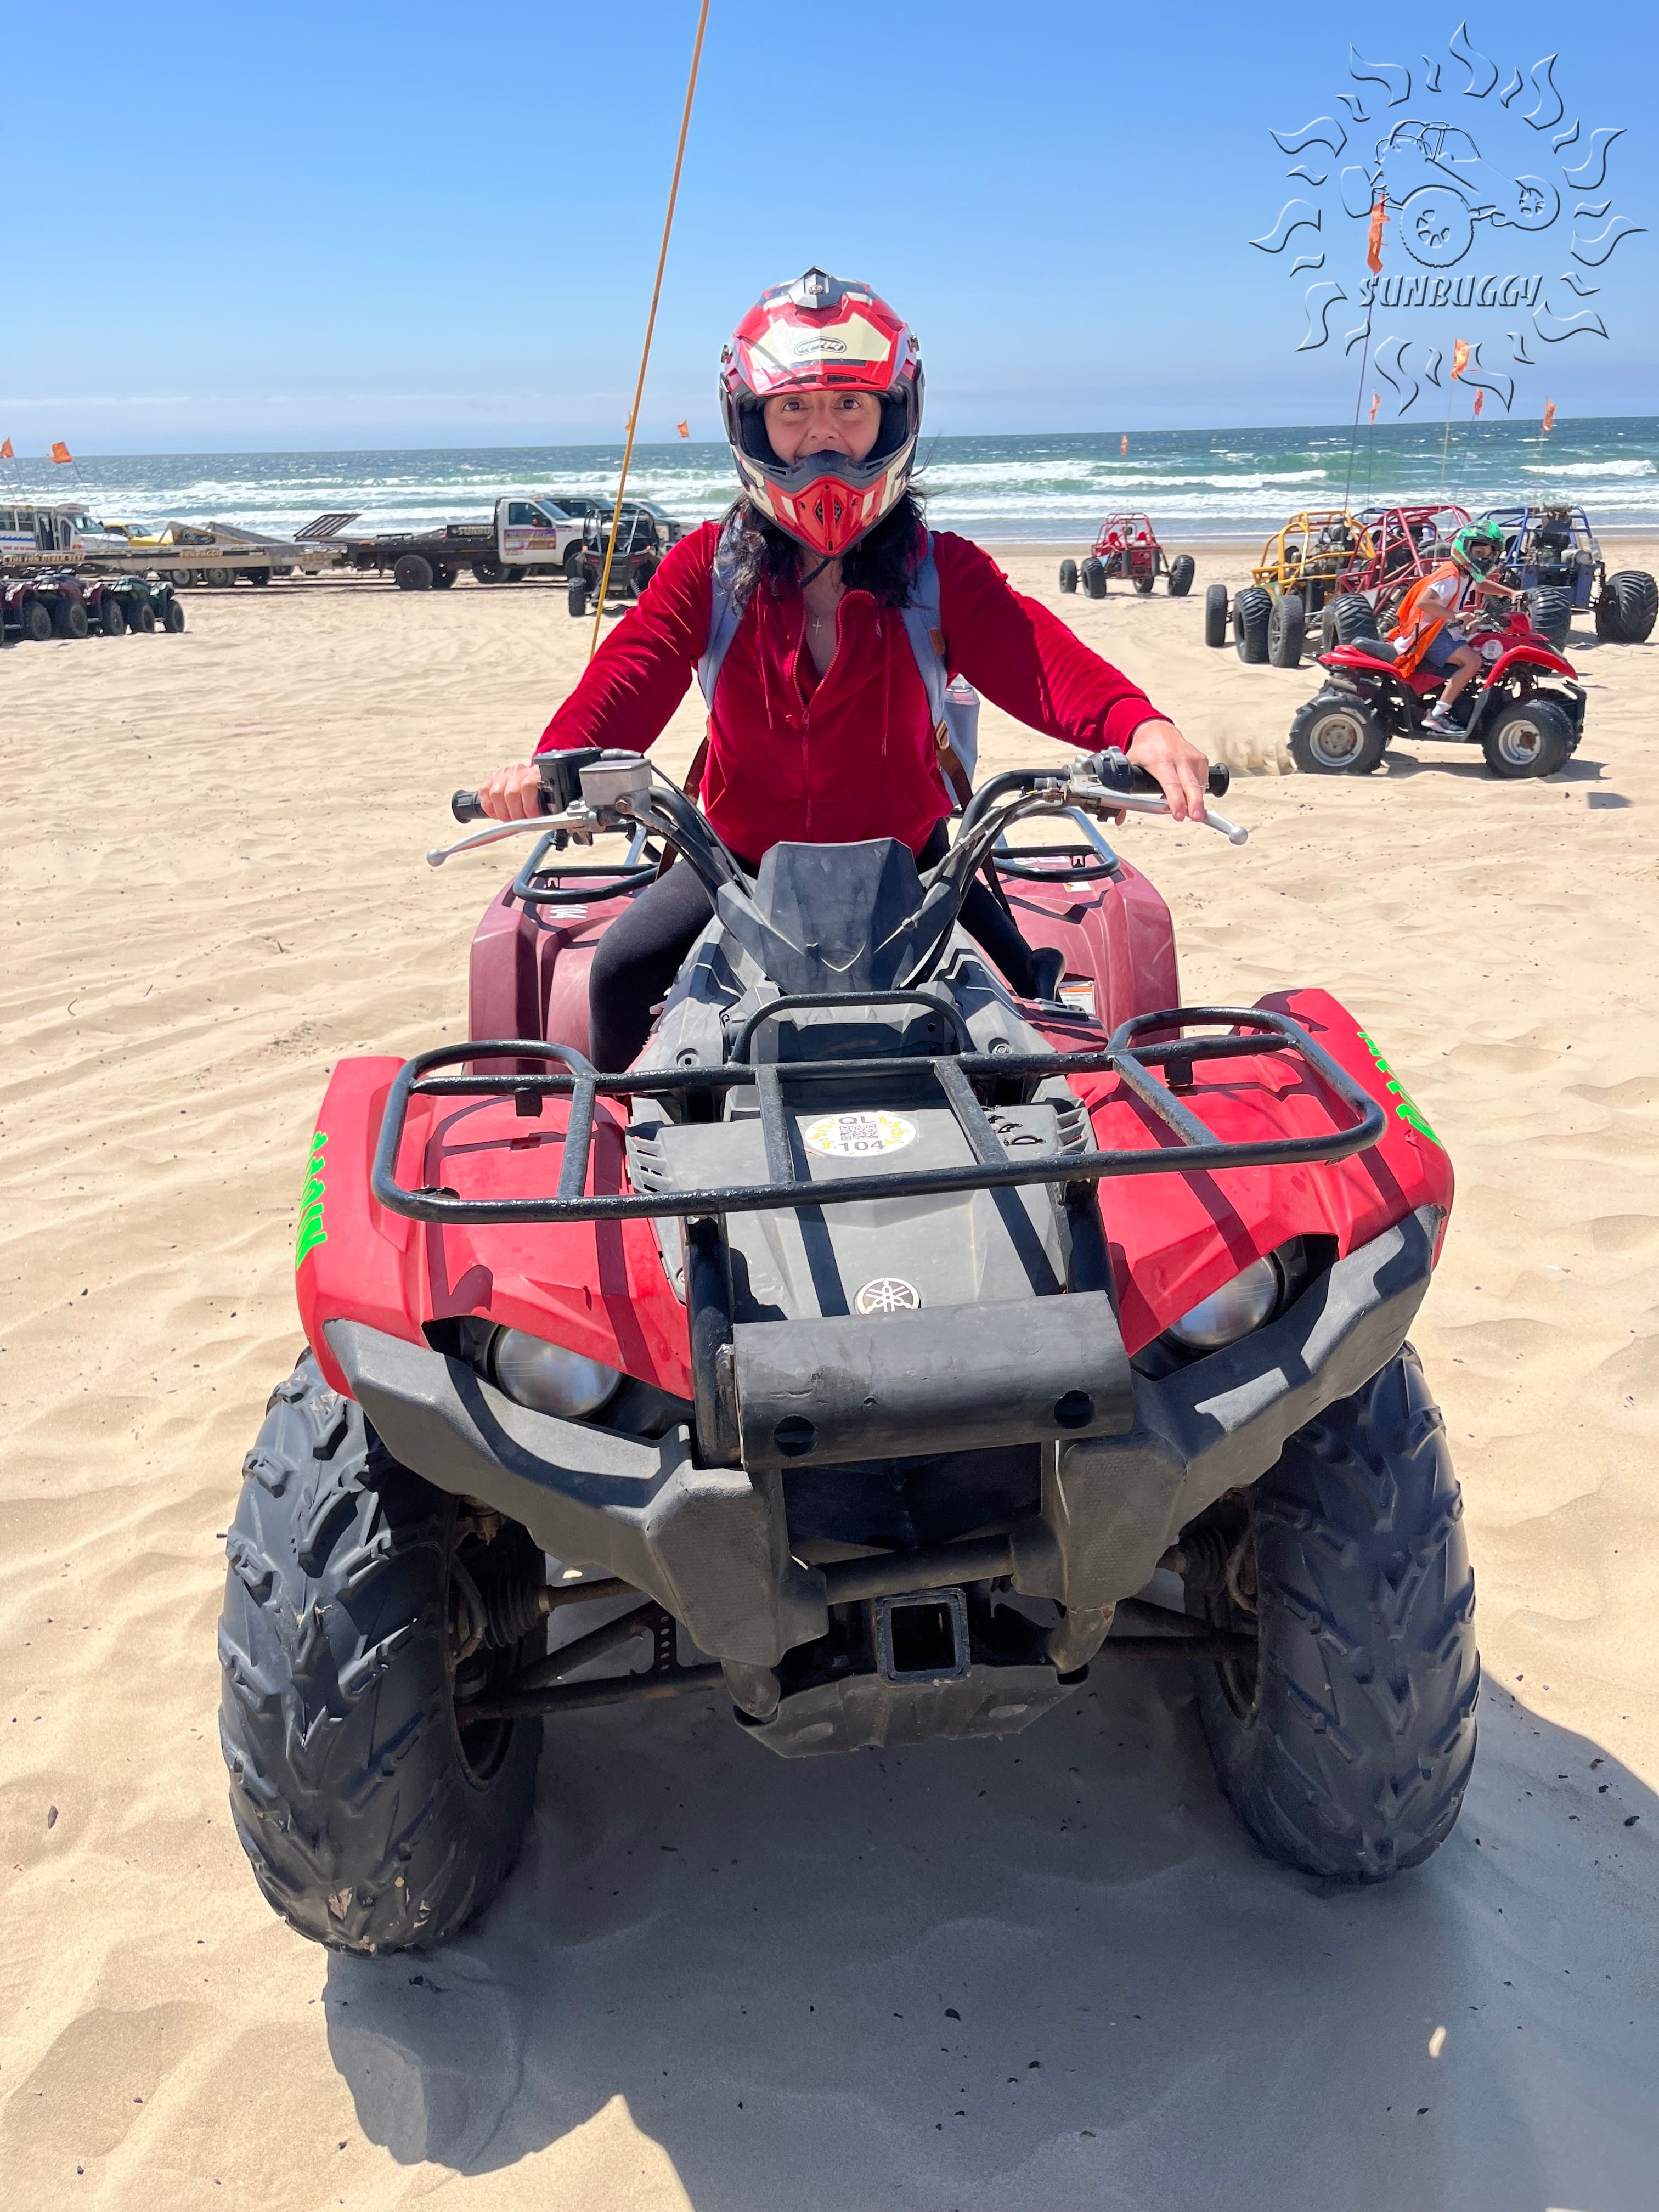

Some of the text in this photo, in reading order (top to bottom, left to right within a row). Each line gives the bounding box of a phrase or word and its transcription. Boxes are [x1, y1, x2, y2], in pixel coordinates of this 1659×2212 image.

[549, 904, 589, 919] 104
[838, 1116, 877, 1125] QL
[838, 1139, 885, 1152] 104
